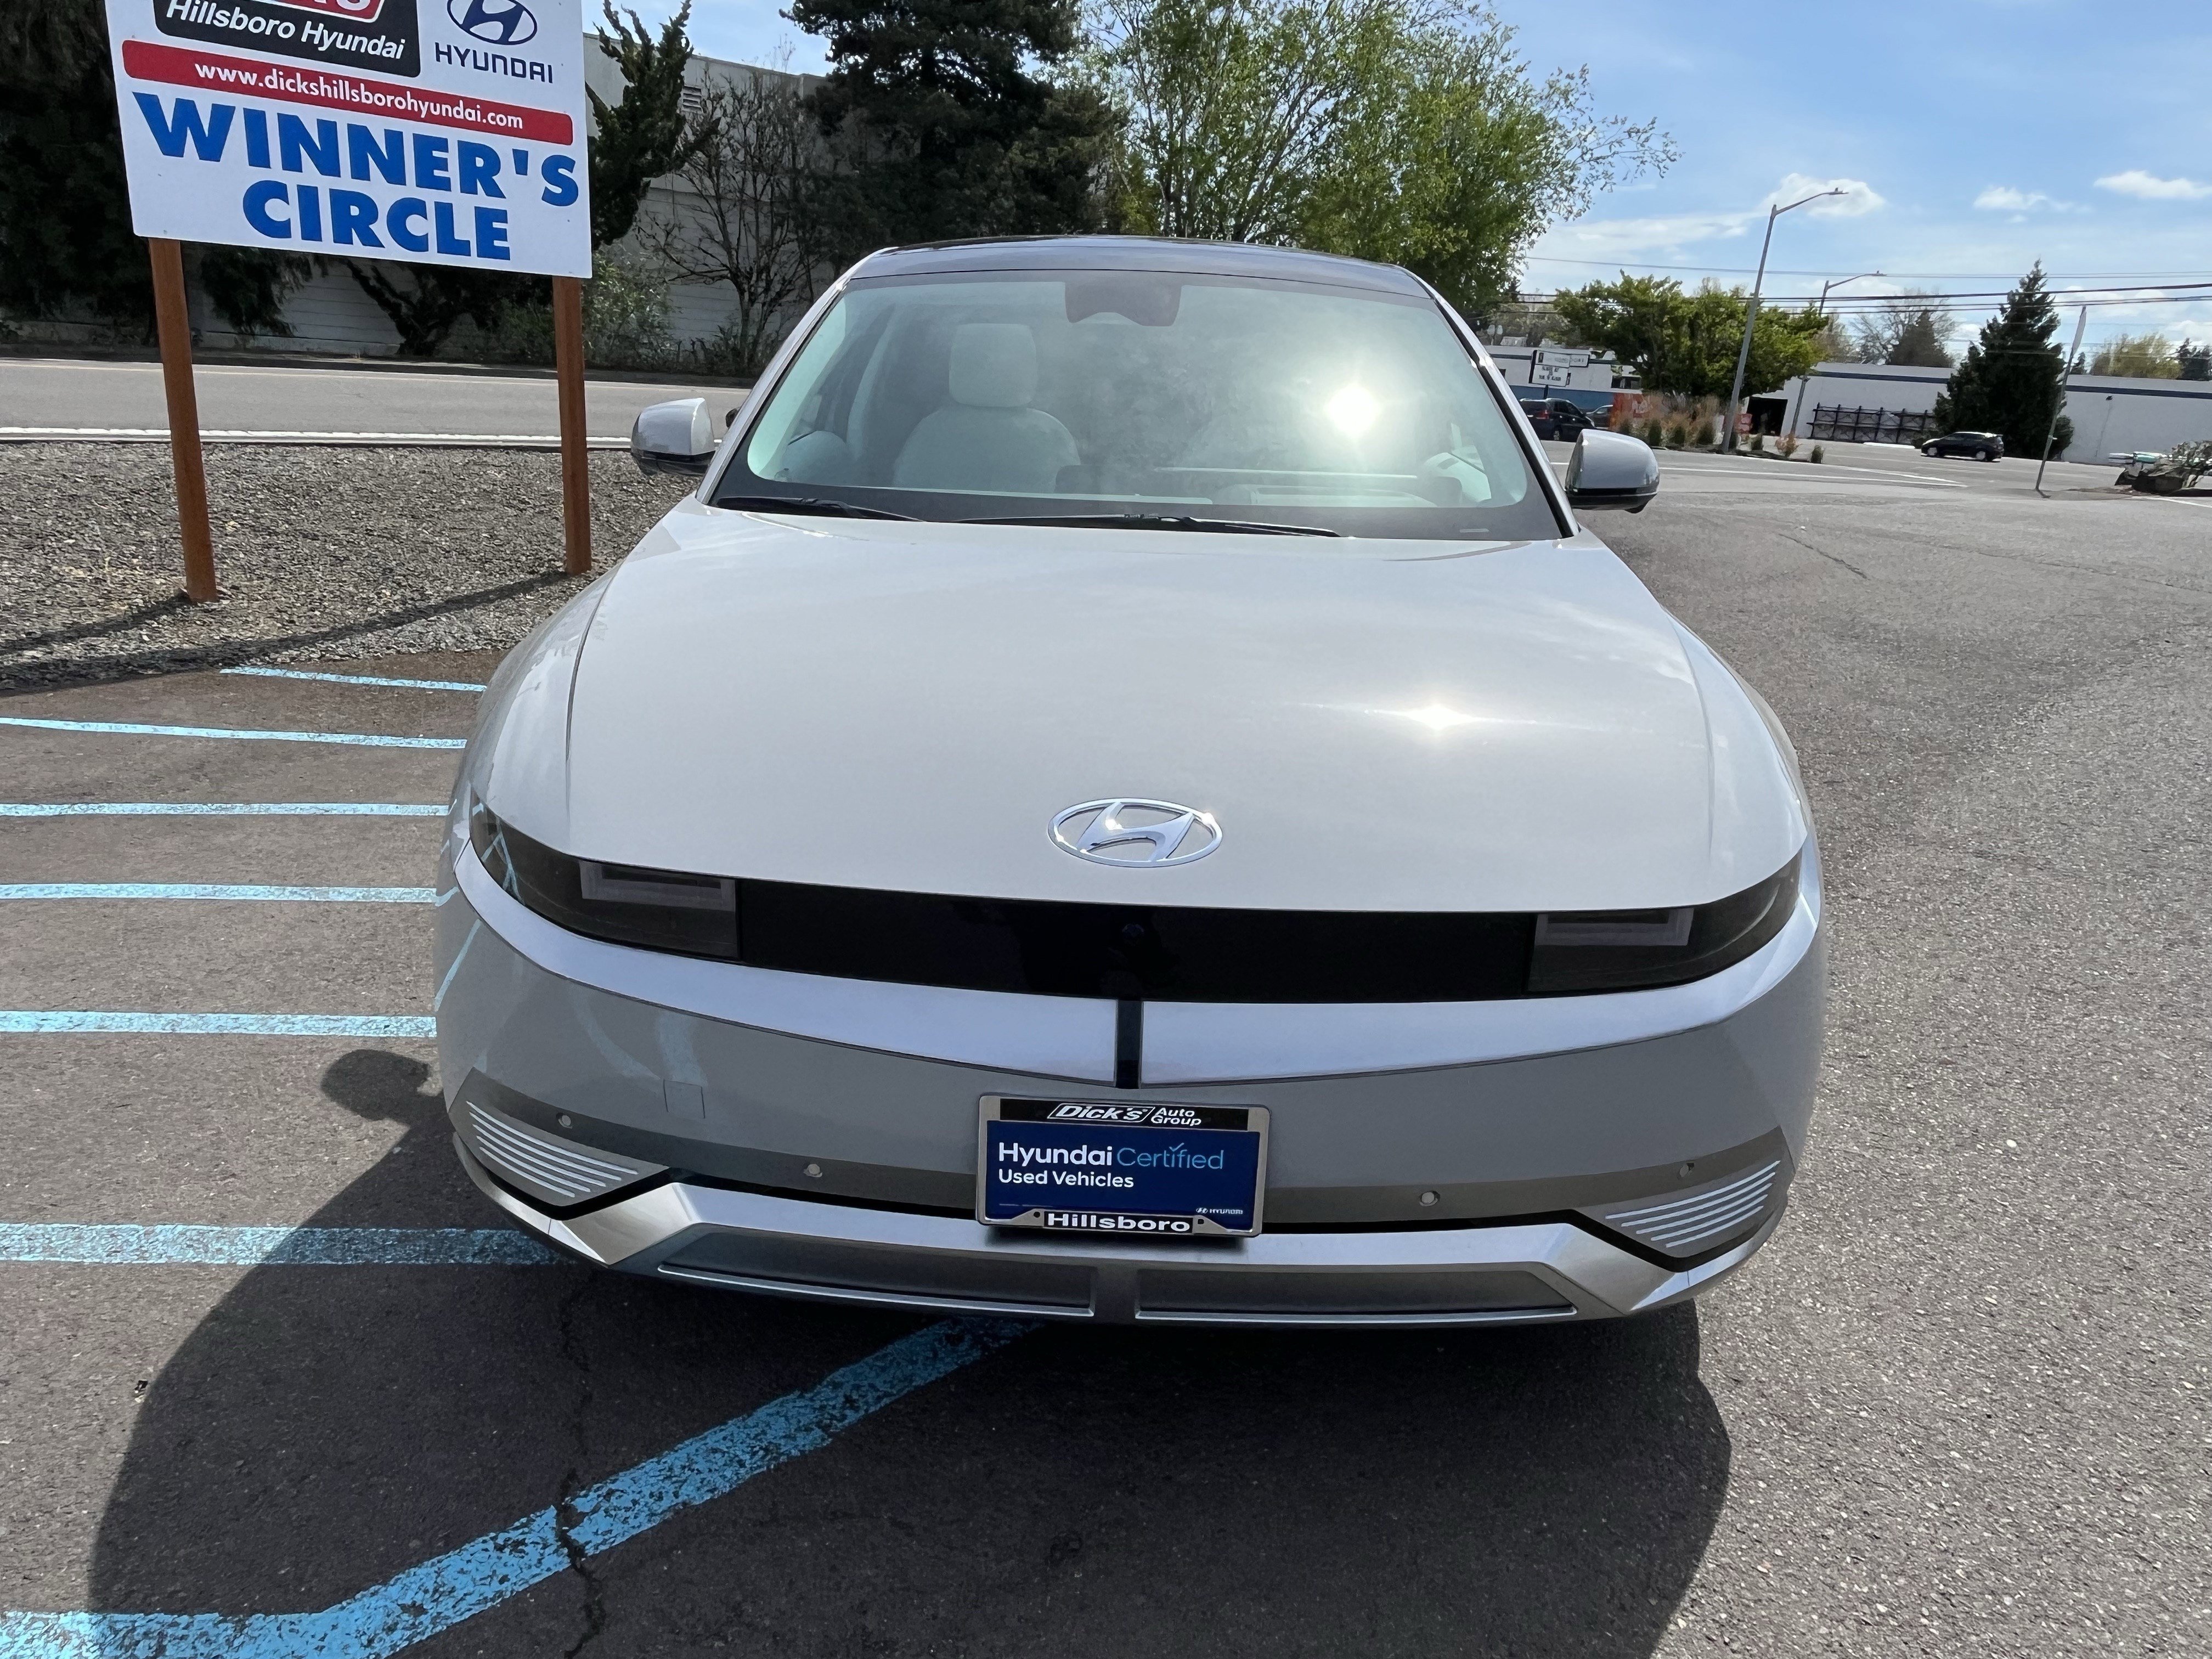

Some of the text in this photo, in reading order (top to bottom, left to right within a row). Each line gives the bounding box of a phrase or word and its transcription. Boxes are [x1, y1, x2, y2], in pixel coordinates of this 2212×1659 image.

[166, 0, 406, 60] Hillsboro Hyundai
[434, 42, 554, 84] HYUNDAI
[194, 61, 523, 129] www.dickshillsborohyundai.com
[132, 92, 579, 206] WINNER'S
[242, 180, 511, 261] CIRCLE
[1150, 1115, 1202, 1127] Group
[1154, 1107, 1195, 1118] Auto
[998, 1142, 1224, 1170] Hyundai Certified
[998, 1169, 1135, 1188] Used Vehicles
[1047, 1213, 1190, 1232] Hillsboro
